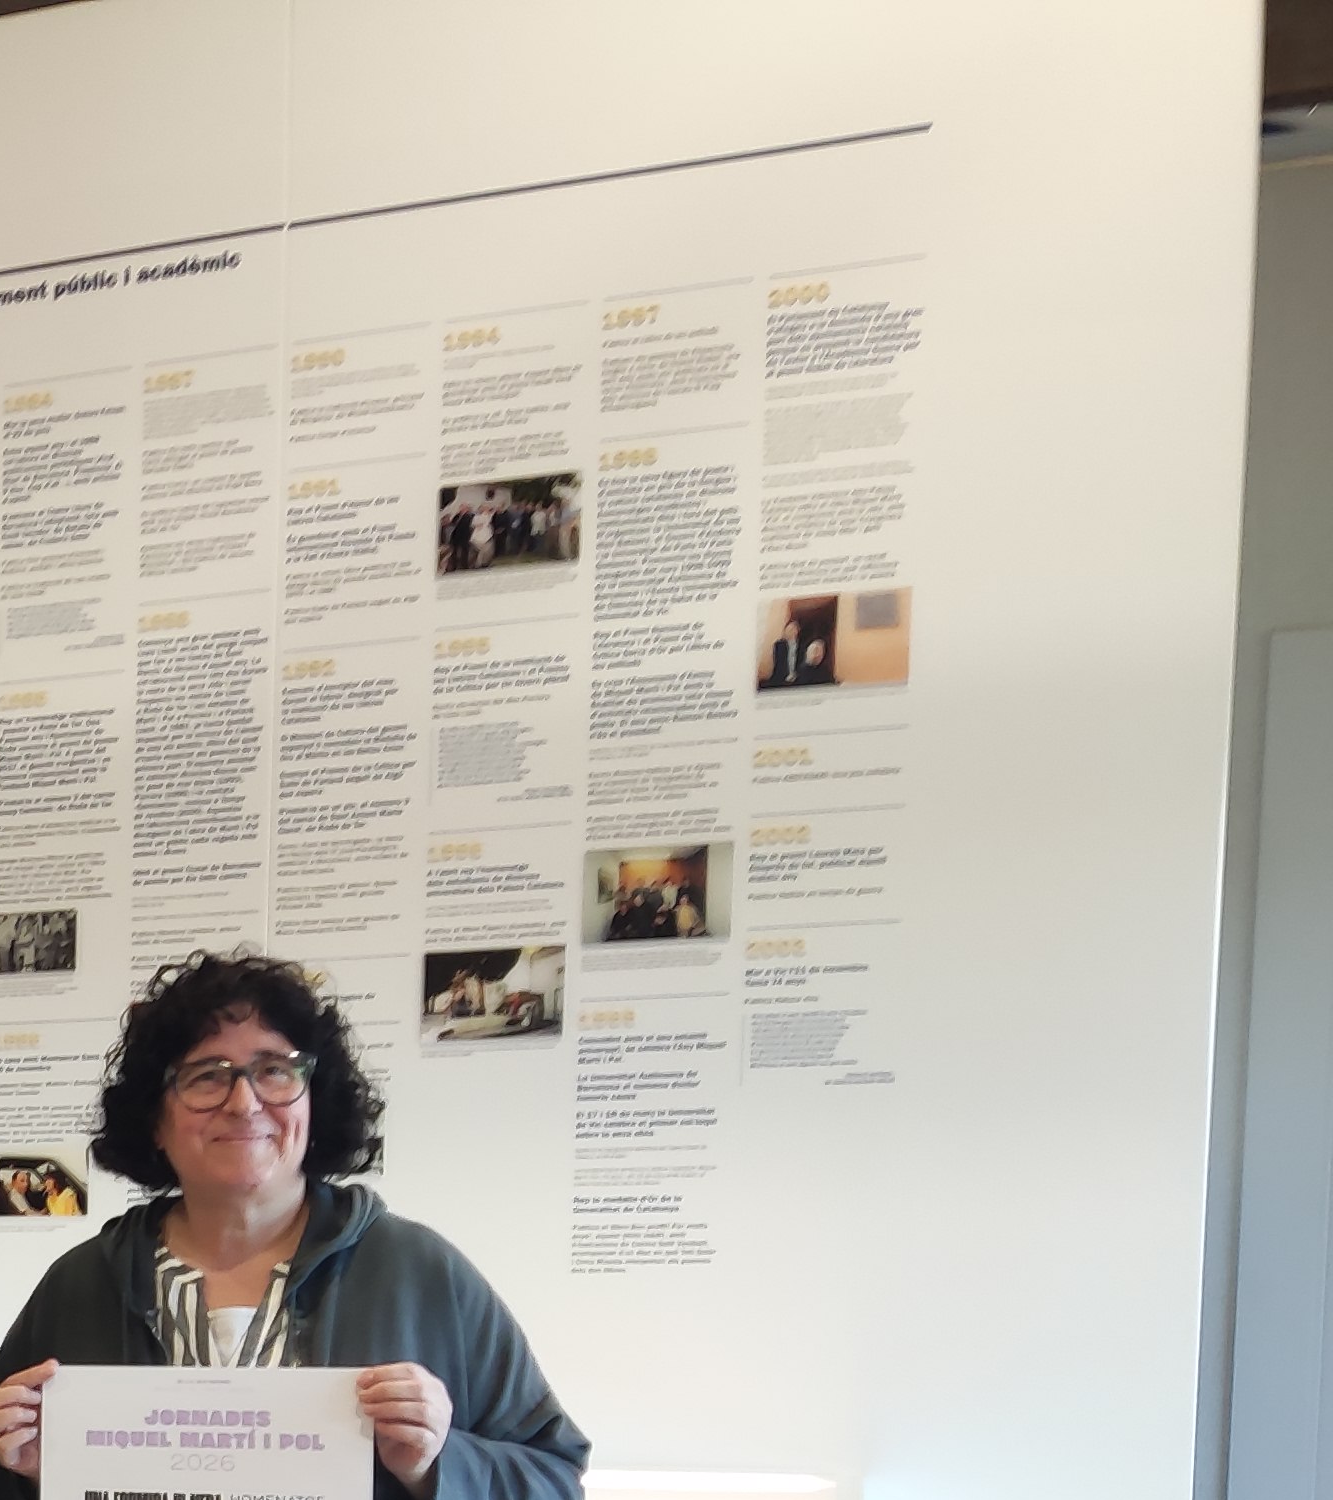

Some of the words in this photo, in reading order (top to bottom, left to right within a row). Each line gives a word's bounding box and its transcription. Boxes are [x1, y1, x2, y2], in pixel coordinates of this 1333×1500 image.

[54, 271, 117, 300] públic
[144, 1409, 270, 1427] JORNADES
[86, 1430, 172, 1449] MIQUEL
[180, 1428, 255, 1449] MARTÍ
[264, 1433, 271, 1449] I
[279, 1434, 325, 1451] POL
[170, 1454, 235, 1472] 2026
